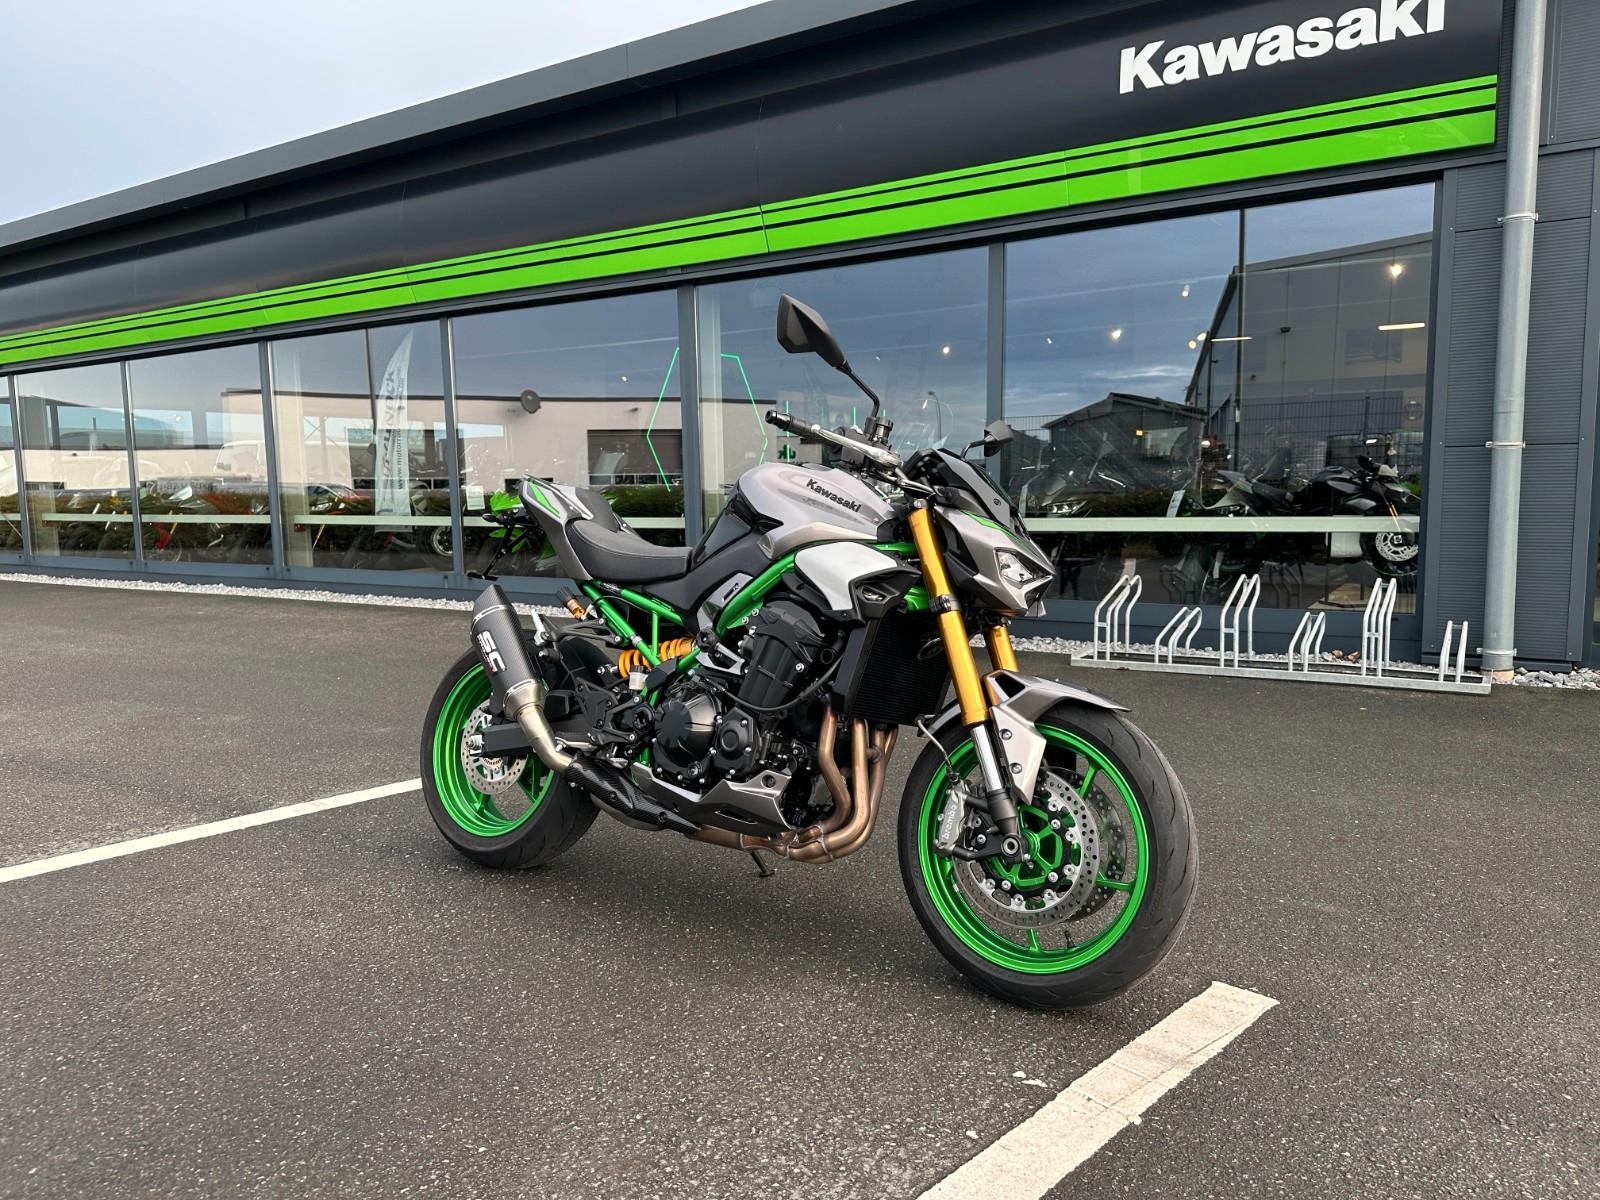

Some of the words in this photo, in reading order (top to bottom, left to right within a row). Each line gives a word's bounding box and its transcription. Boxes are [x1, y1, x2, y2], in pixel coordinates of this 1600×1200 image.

[1120, 0, 1445, 94] Kawasaki
[806, 478, 861, 512] Kawasaki
[942, 805, 957, 839] brembo
